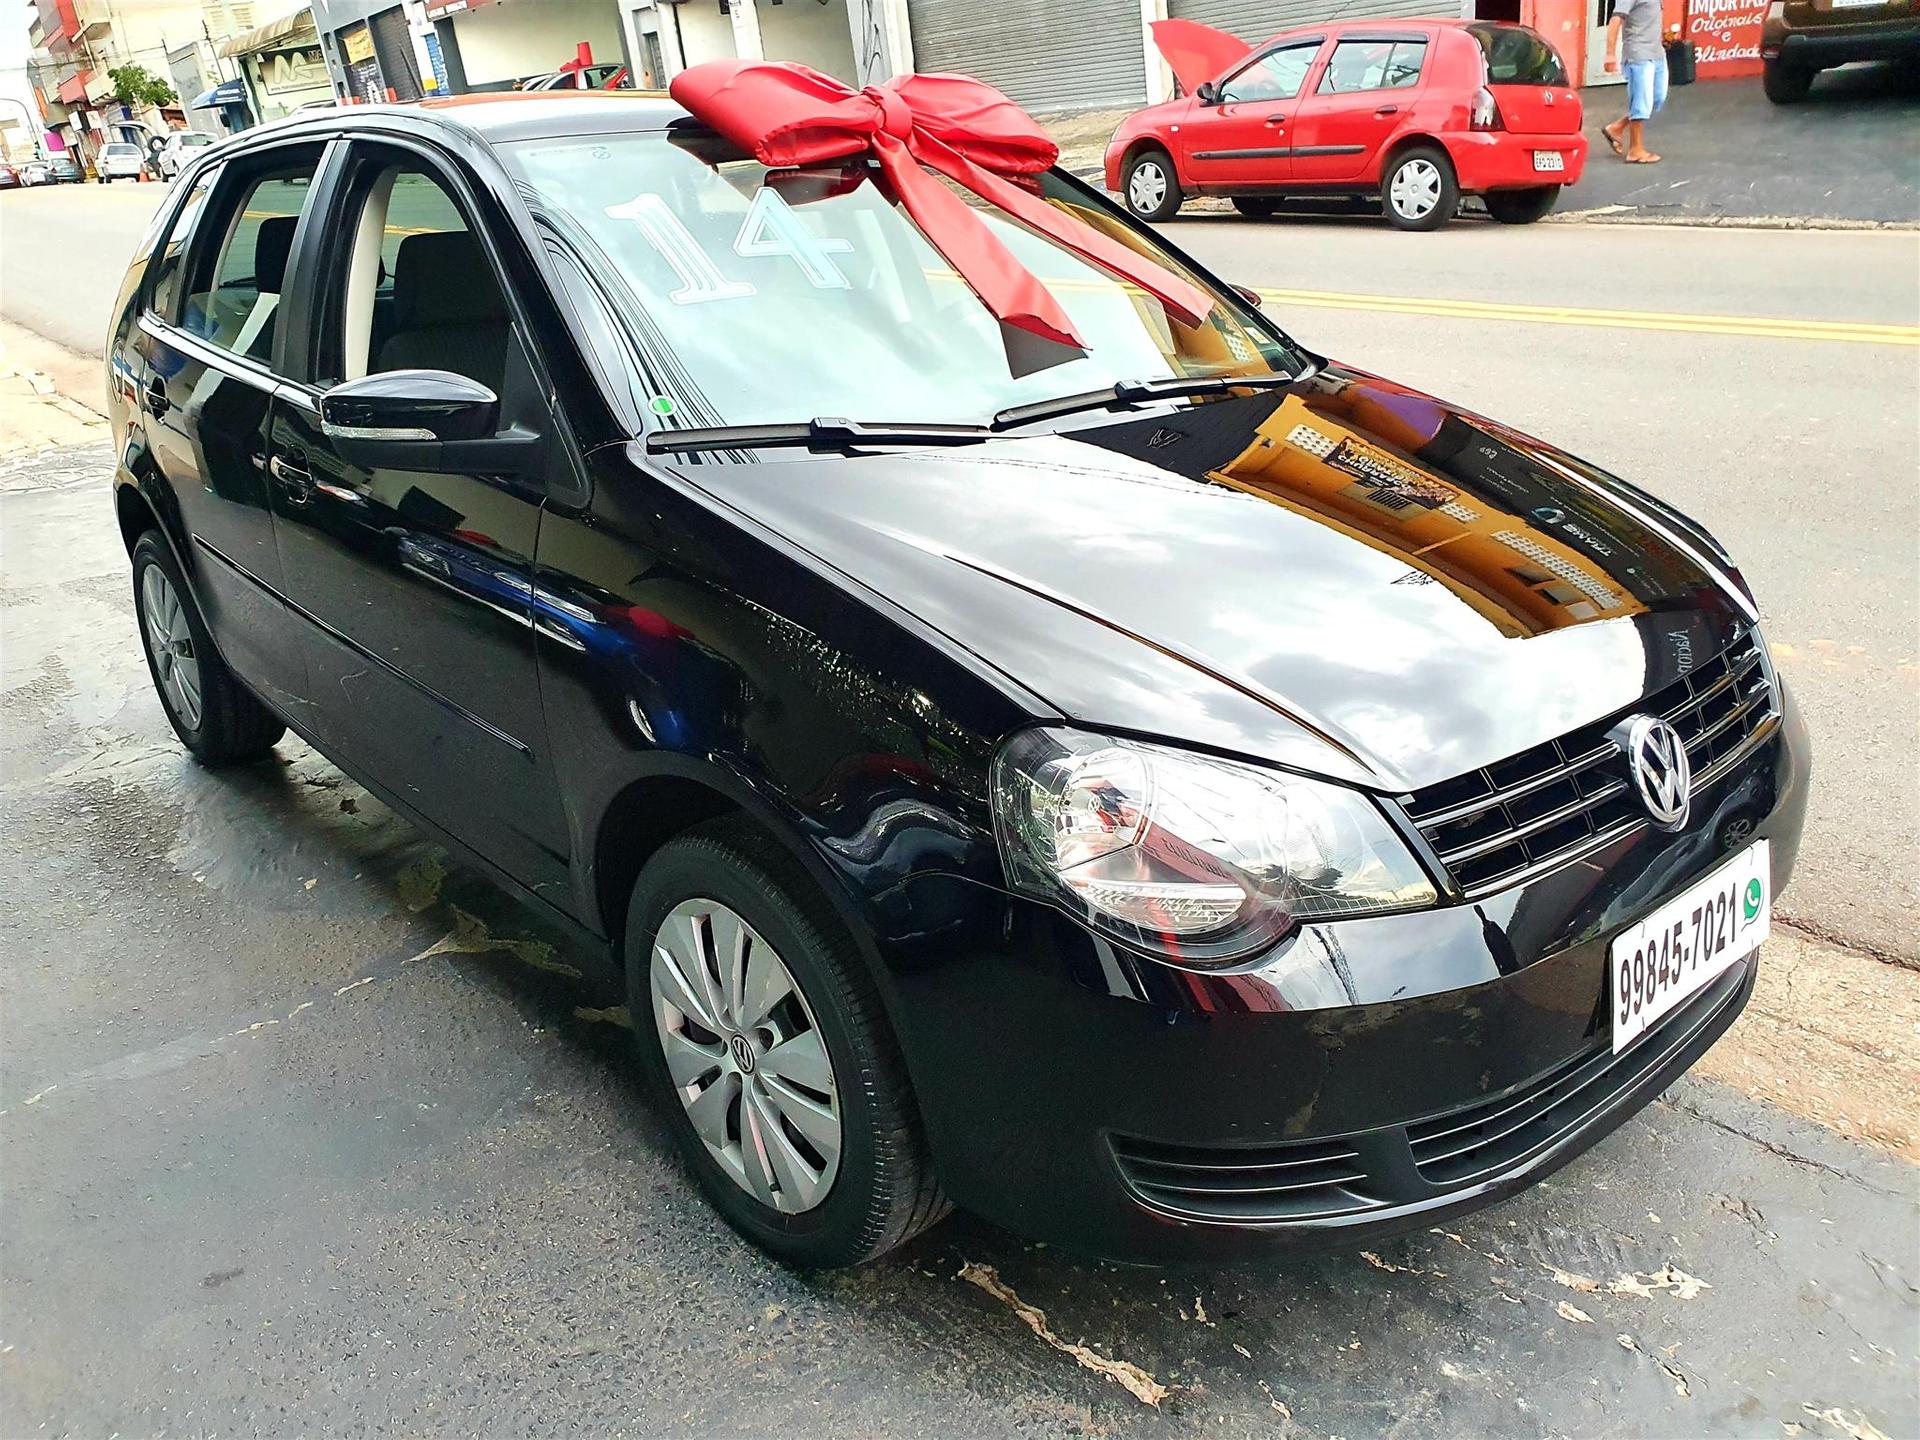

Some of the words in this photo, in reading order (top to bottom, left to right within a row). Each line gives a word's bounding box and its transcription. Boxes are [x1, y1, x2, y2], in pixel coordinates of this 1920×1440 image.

[1721, 30, 1732, 42] e
[604, 186, 855, 305] 14
[1620, 882, 1737, 1026] 99845-7021
